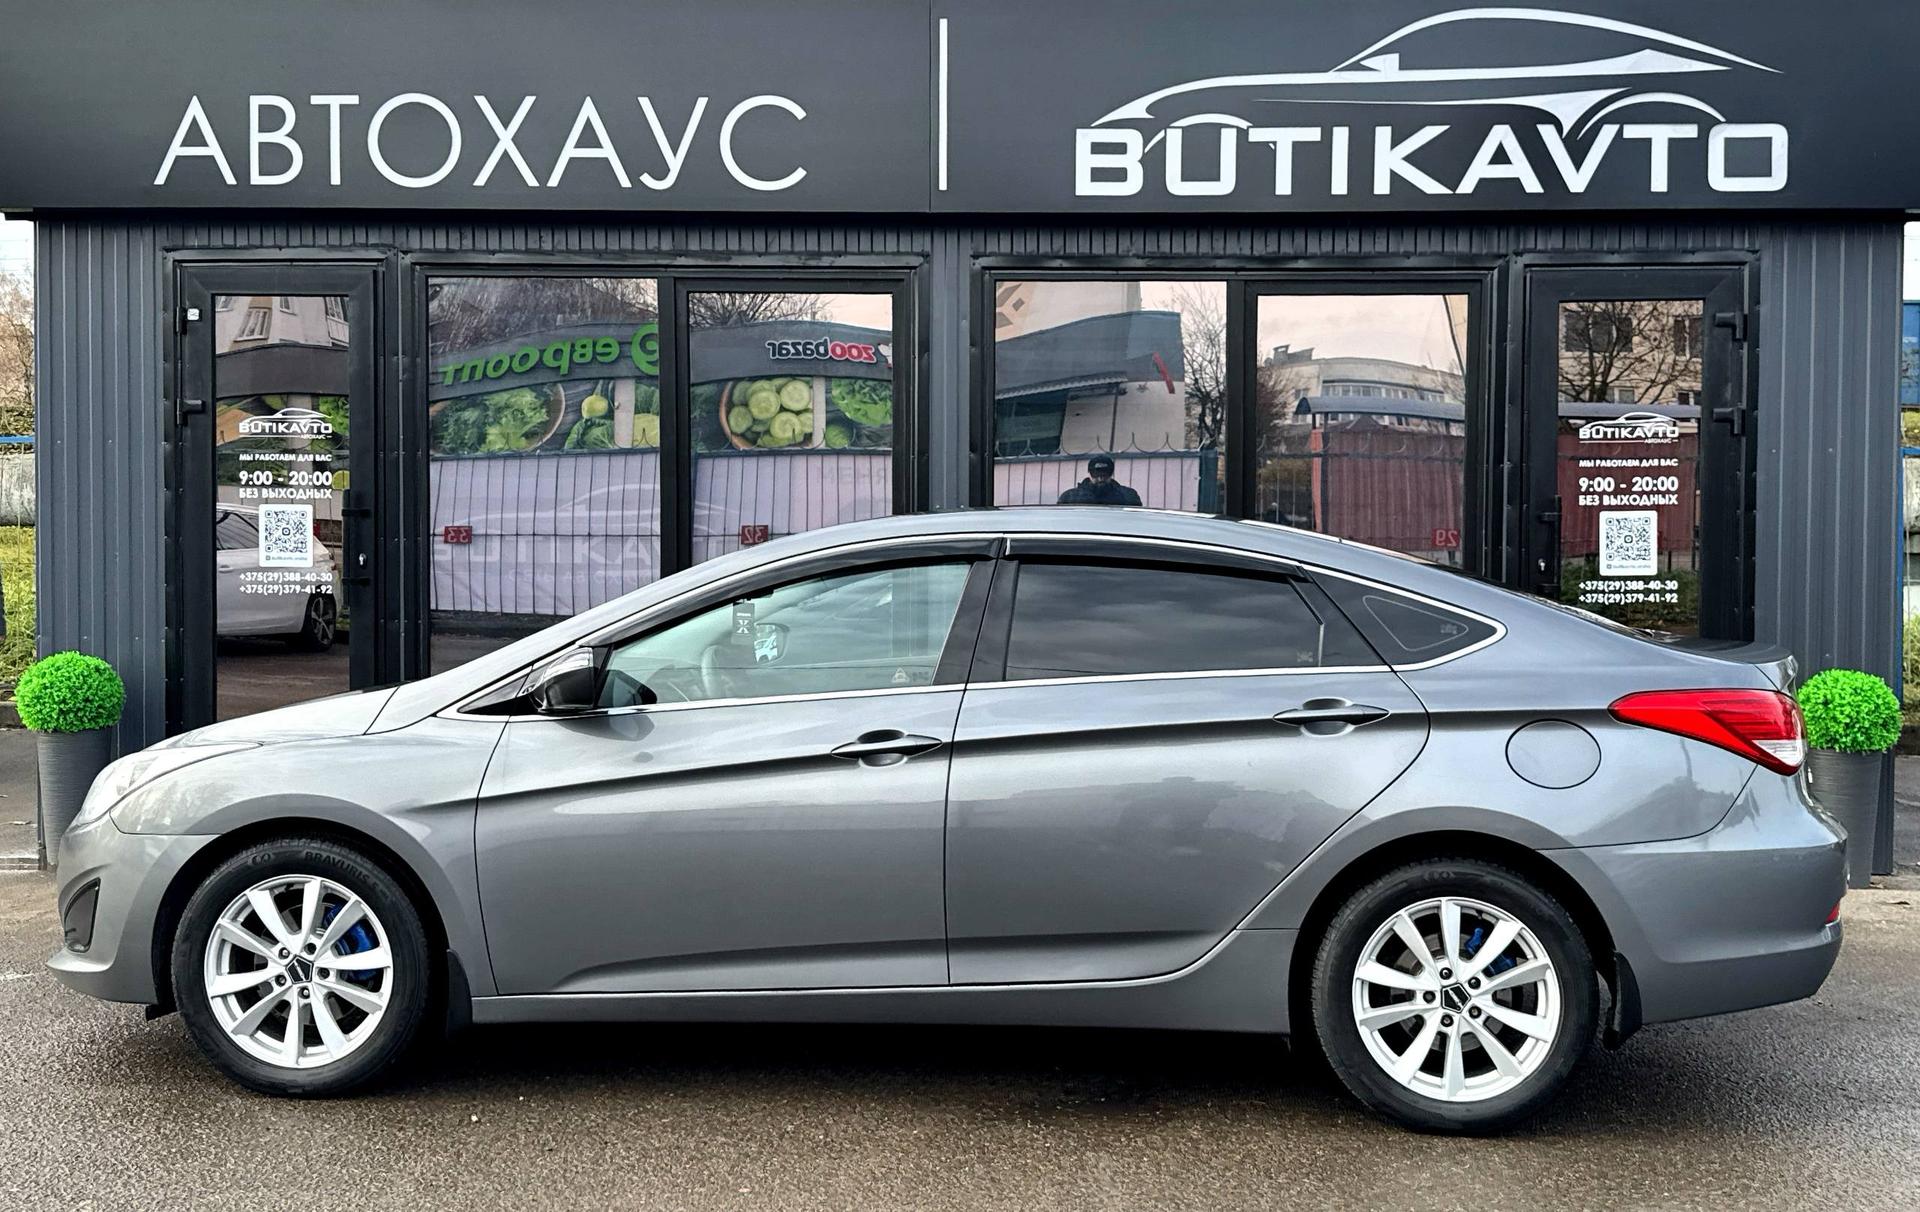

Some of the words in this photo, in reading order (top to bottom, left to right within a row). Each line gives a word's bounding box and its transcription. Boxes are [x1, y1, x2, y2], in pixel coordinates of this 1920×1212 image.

[154, 93, 808, 190] АВТОХАУС
[1075, 123, 1788, 196] BUTIKAVTO
[239, 422, 333, 434] BUTIKAVTO
[1579, 426, 1679, 439] BUTIKAVTO
[315, 453, 333, 462] ВАС
[1660, 458, 1679, 467] ВАС
[239, 470, 273, 486] 9:00
[288, 470, 333, 486] 20:00
[1578, 476, 1615, 492] 9:00
[1631, 476, 1679, 492] 20:00
[239, 488, 259, 499] БЕЗ
[261, 488, 333, 499] ВЫХОДНЫХ
[1578, 494, 1600, 506] БЕЗ
[1602, 494, 1679, 506] ВЫХОДНЫХ
[239, 585, 333, 595] +375(29)379-41-92
[1578, 593, 1679, 604] +375(29)379-41-92
[304, 851, 370, 883] BRAVURIS
